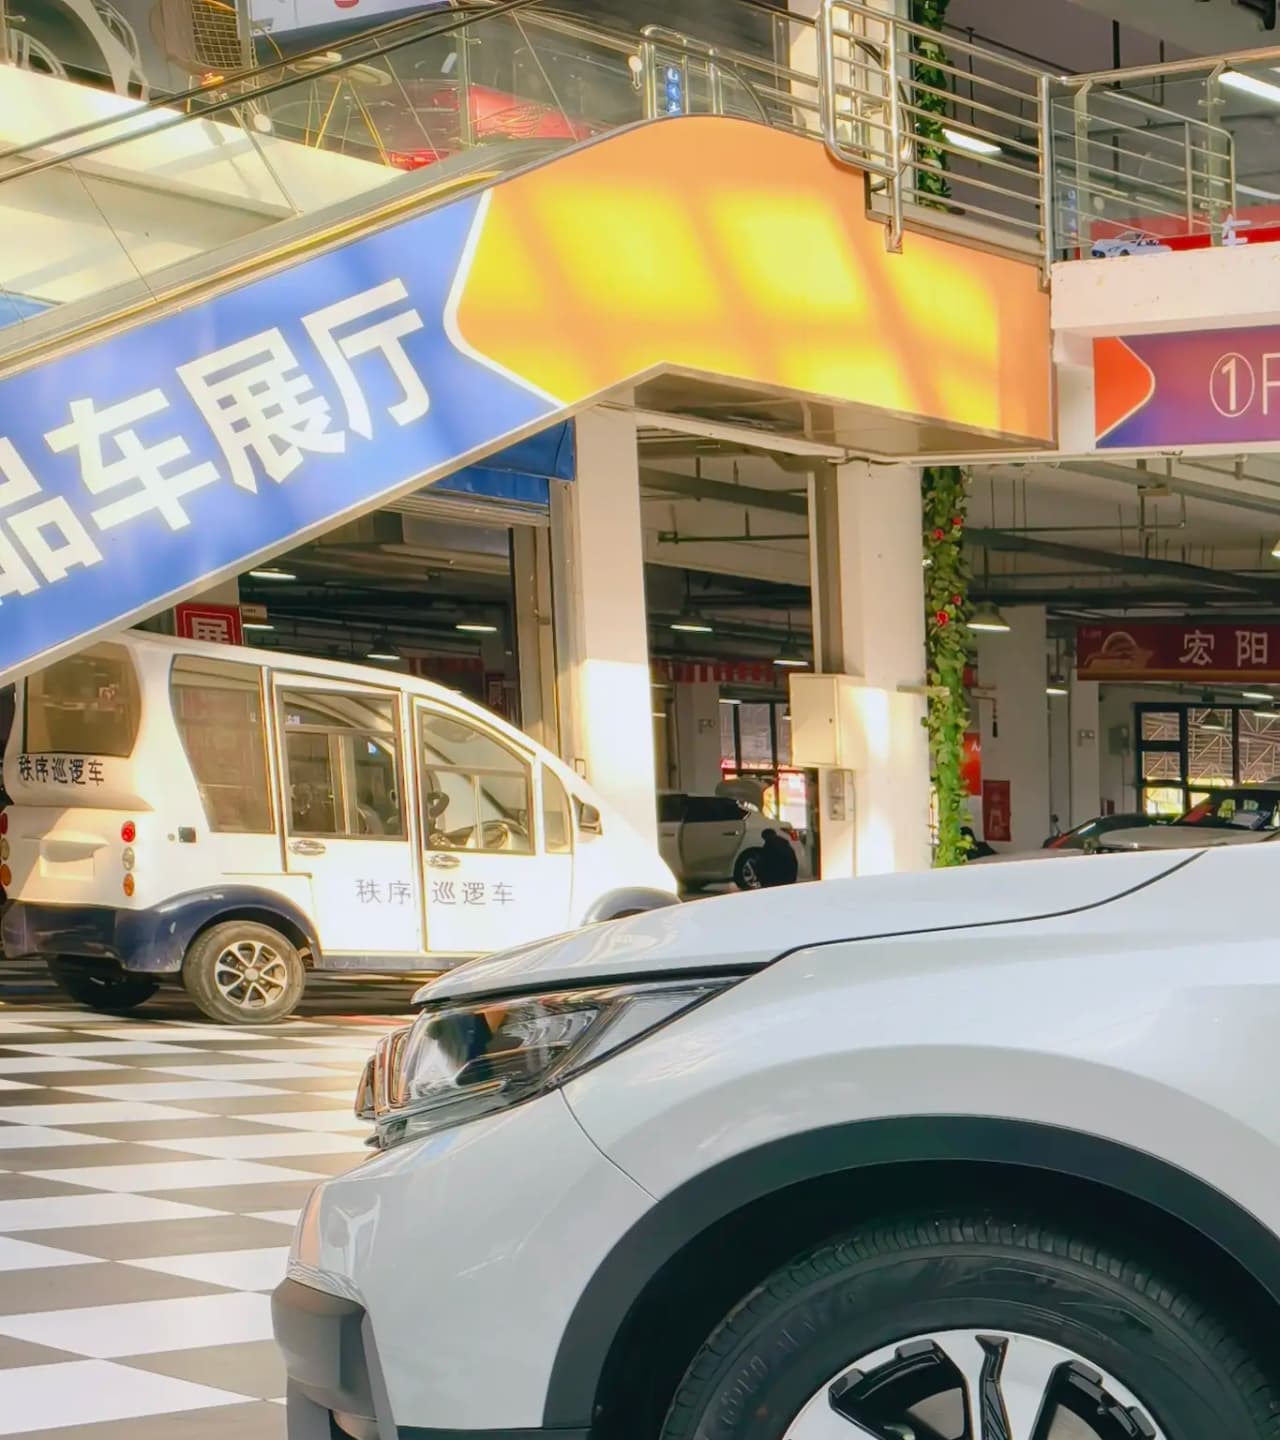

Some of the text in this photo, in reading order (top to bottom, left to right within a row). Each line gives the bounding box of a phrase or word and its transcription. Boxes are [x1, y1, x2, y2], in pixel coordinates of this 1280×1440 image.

[18, 755, 105, 786] 秩序巡逻车
[355, 879, 516, 905] 秩序巡逻车
